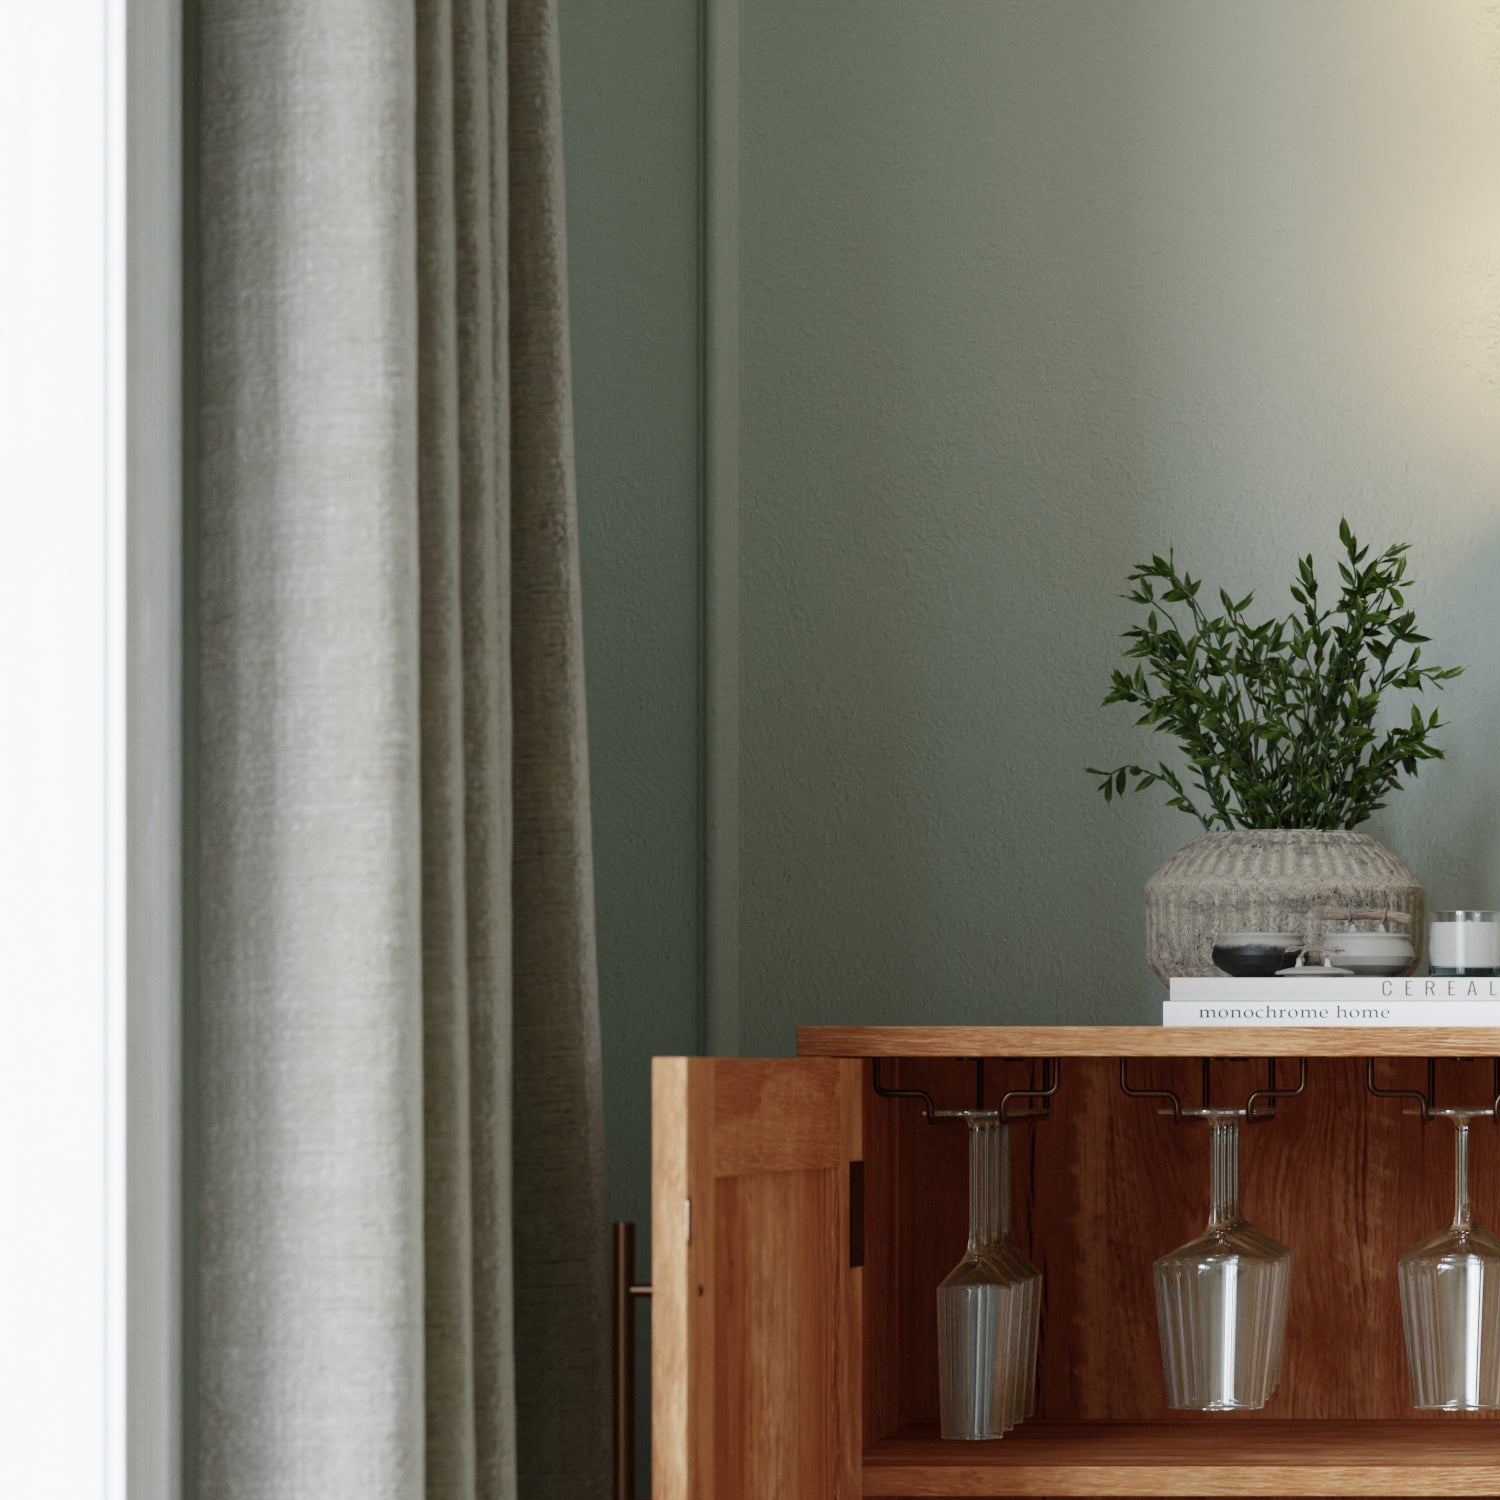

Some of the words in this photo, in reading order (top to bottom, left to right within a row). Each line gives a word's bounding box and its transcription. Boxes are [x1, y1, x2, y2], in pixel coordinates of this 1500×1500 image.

[1381, 980, 1497, 996] CEREAL
[1199, 1005, 1329, 1019] monochrome
[1336, 1005, 1391, 1019] home
